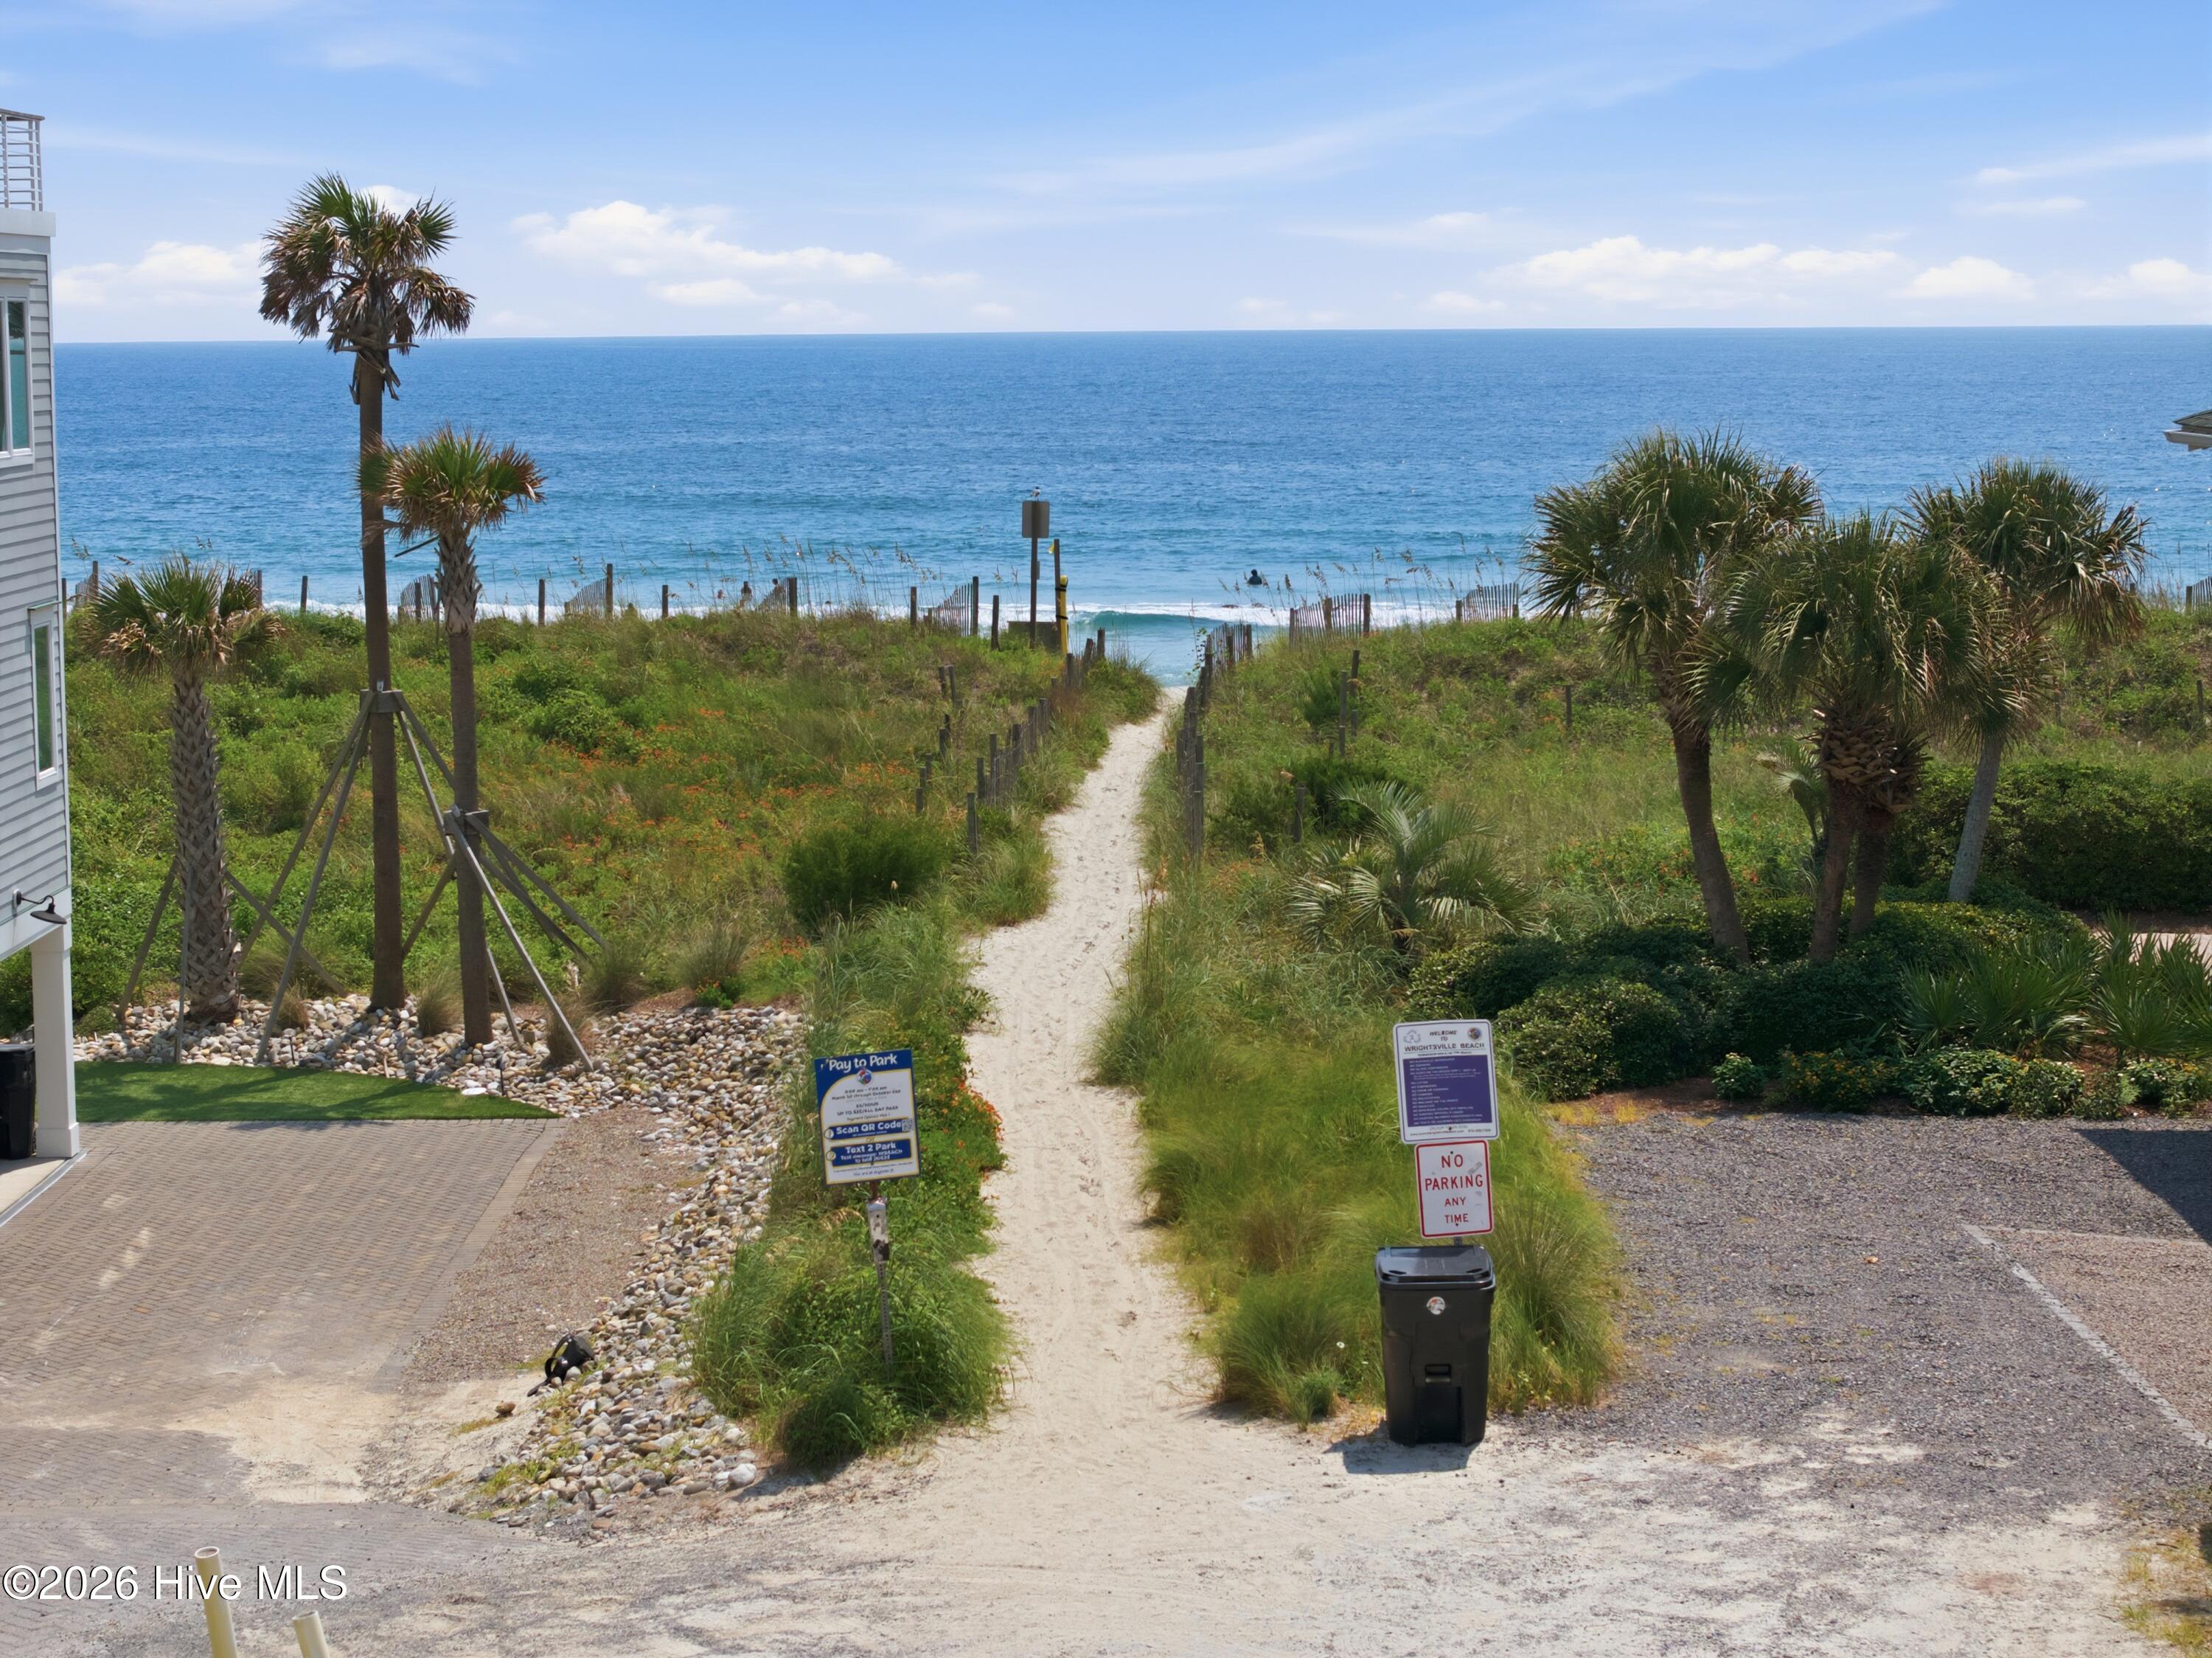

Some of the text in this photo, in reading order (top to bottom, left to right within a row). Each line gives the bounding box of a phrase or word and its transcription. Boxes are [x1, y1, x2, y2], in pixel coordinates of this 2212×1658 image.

[1405, 1043, 1457, 1052] WRIGHTSVILLE
[828, 1053, 897, 1073] Pay to Park
[836, 1126, 859, 1134] Scan
[860, 1123, 875, 1132] QR
[877, 1120, 902, 1130] Code
[845, 1142, 897, 1154] Text 2 Park
[1441, 1154, 1464, 1168] NO
[1425, 1174, 1484, 1191] PARKING
[1444, 1196, 1467, 1207] ANY
[1444, 1213, 1469, 1224] TIME
